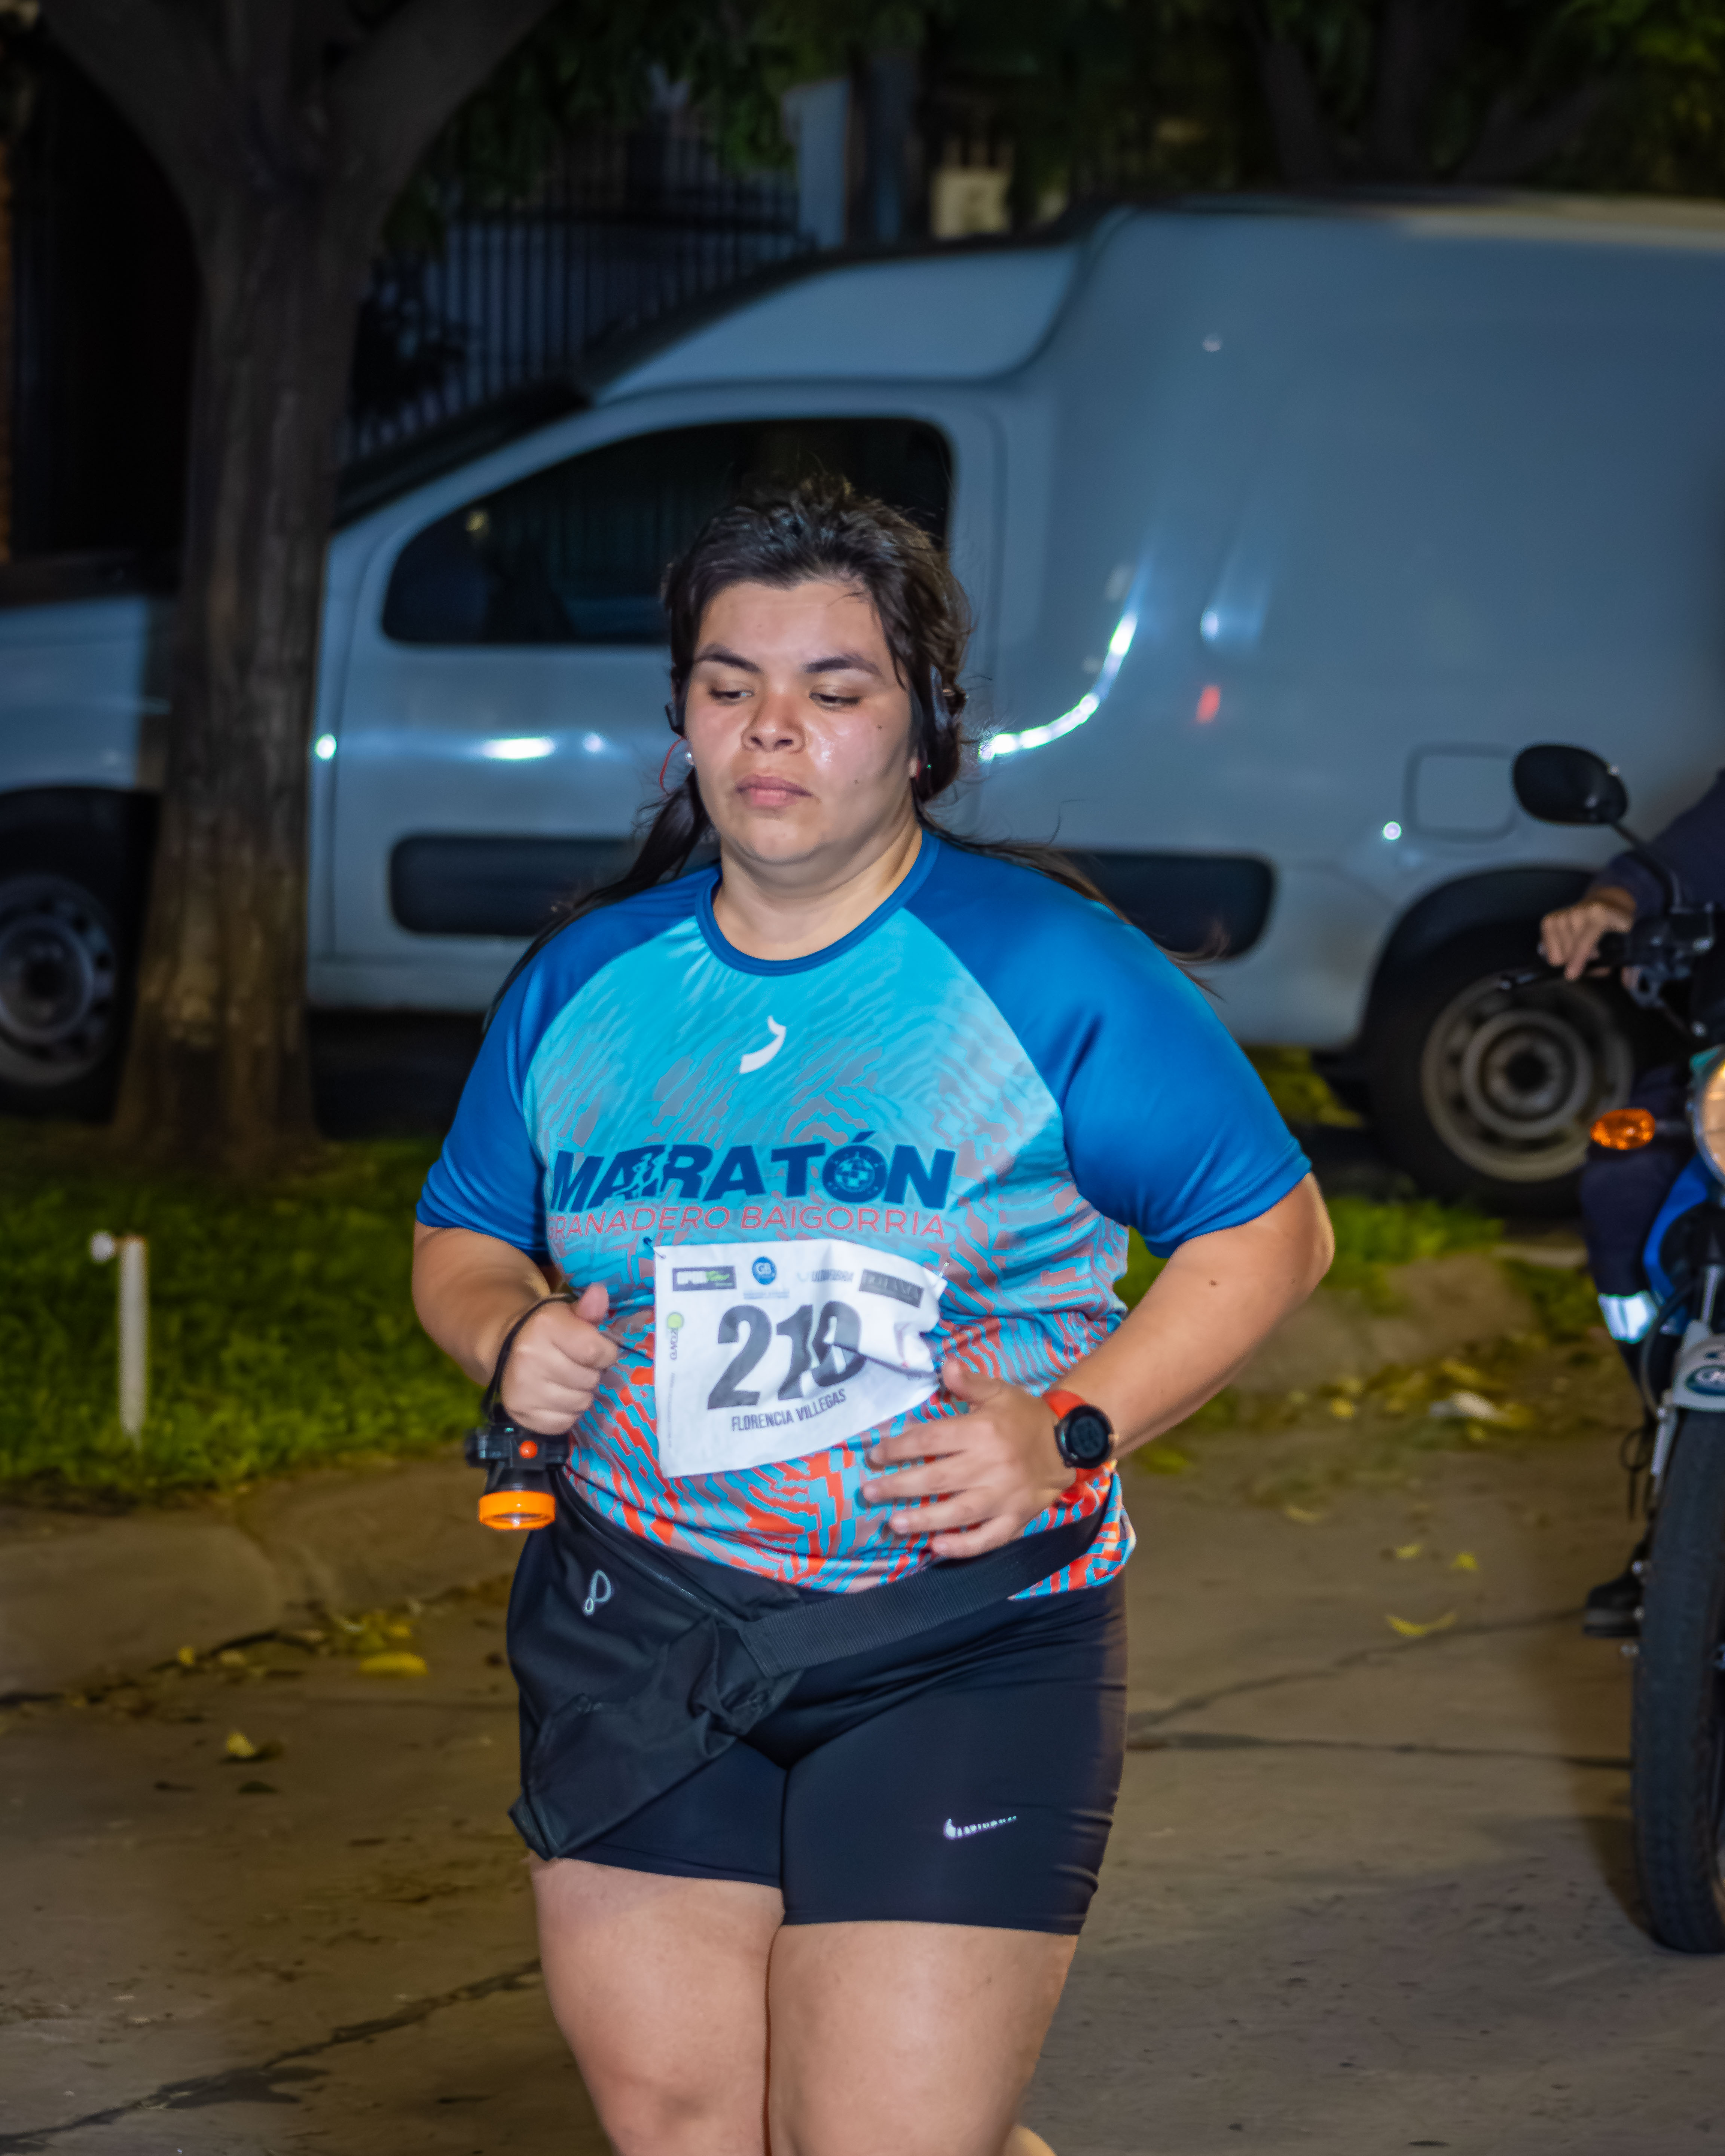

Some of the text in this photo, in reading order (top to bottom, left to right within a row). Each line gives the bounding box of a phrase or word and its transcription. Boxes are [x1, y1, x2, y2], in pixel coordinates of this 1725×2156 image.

[551, 1130, 956, 1212] MARATÓN
[547, 1205, 945, 1240] GRANADERO BAIGORRIA
[732, 1388, 846, 1431] FLORENCIA VILLEGAS
